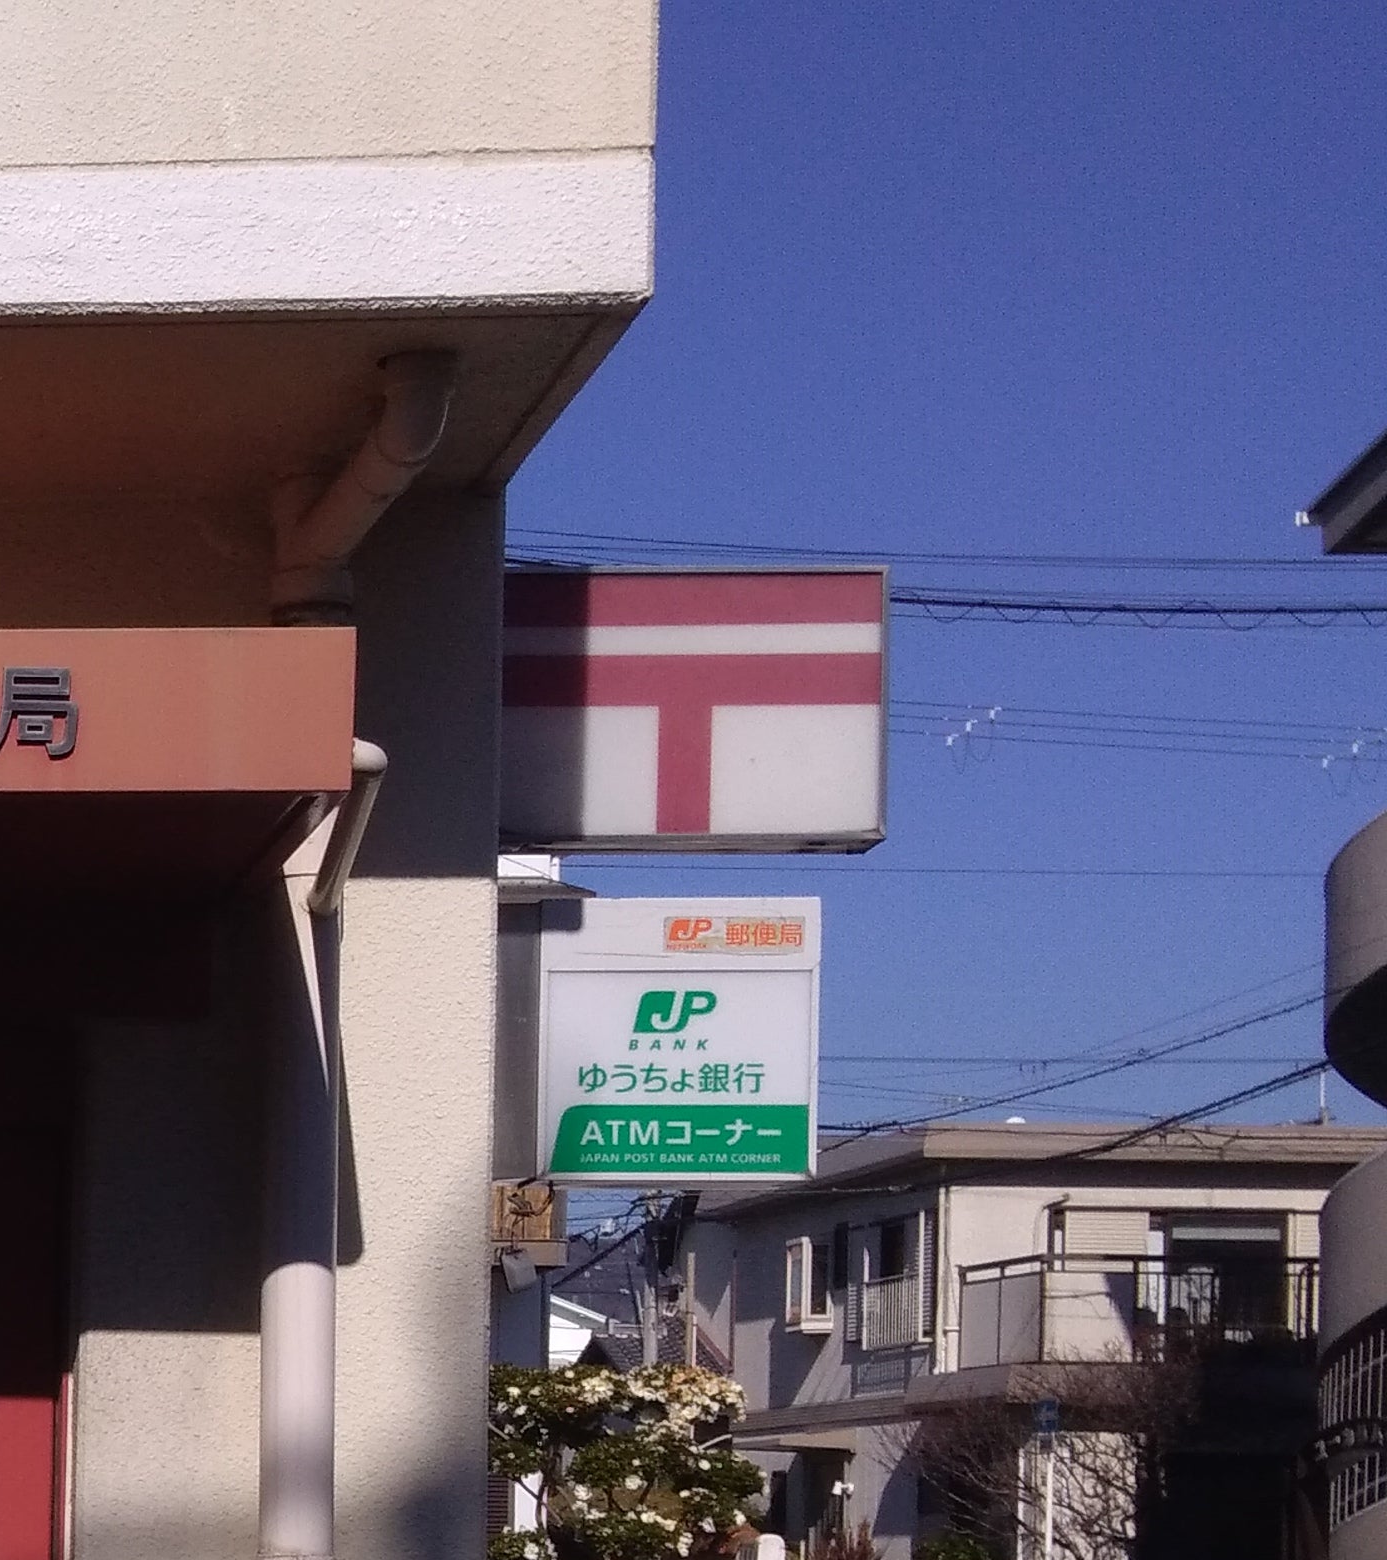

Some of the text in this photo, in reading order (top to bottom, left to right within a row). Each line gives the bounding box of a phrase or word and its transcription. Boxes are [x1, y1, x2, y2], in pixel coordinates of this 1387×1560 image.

[726, 922, 803, 947] 郵便局
[633, 990, 717, 1033] JP
[629, 1038, 709, 1051] BANK
[578, 1063, 765, 1094] ゆうちょ銀行
[580, 1119, 782, 1147] ATMコーナー
[580, 1153, 781, 1164] JAPAN POST BANK ATM CORNER
